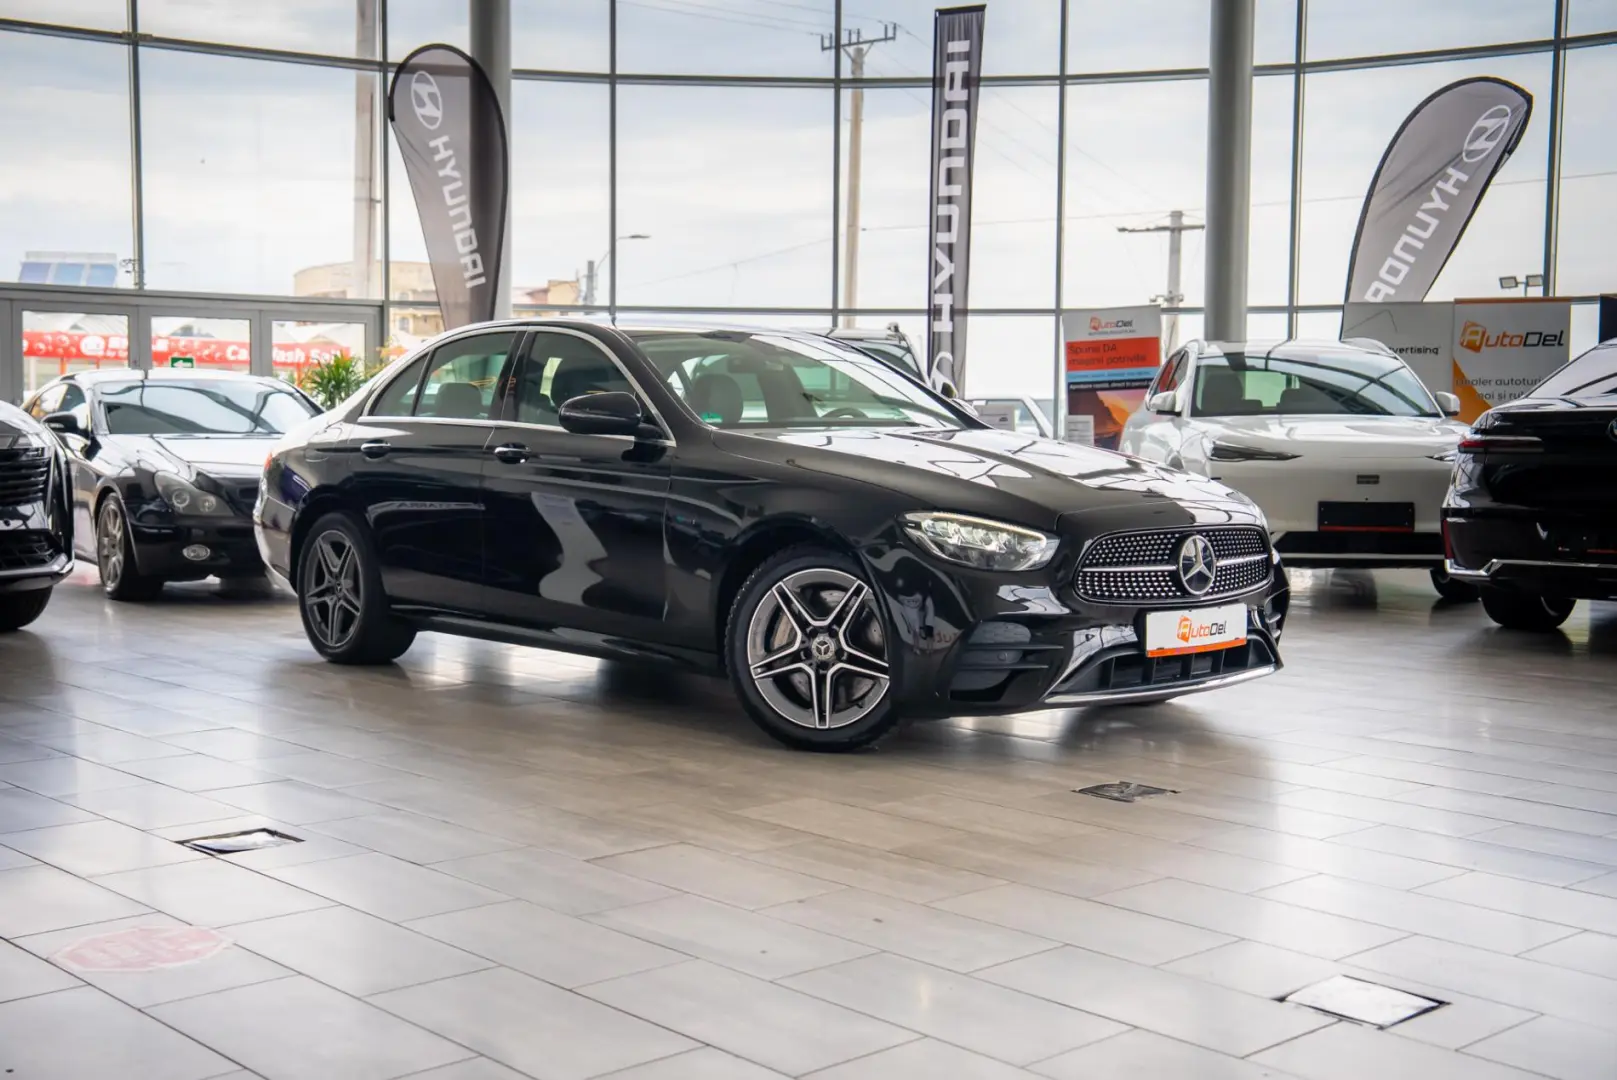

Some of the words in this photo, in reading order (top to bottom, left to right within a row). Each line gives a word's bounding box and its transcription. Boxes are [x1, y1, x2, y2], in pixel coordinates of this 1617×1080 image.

[933, 40, 970, 333] HYUNDAI
[428, 135, 486, 289] HYUNDAI
[1389, 345, 1439, 356] vertising
[1459, 320, 1564, 353] AutoDel
[226, 344, 250, 361] Ca
[1177, 615, 1227, 643] AutoDel
